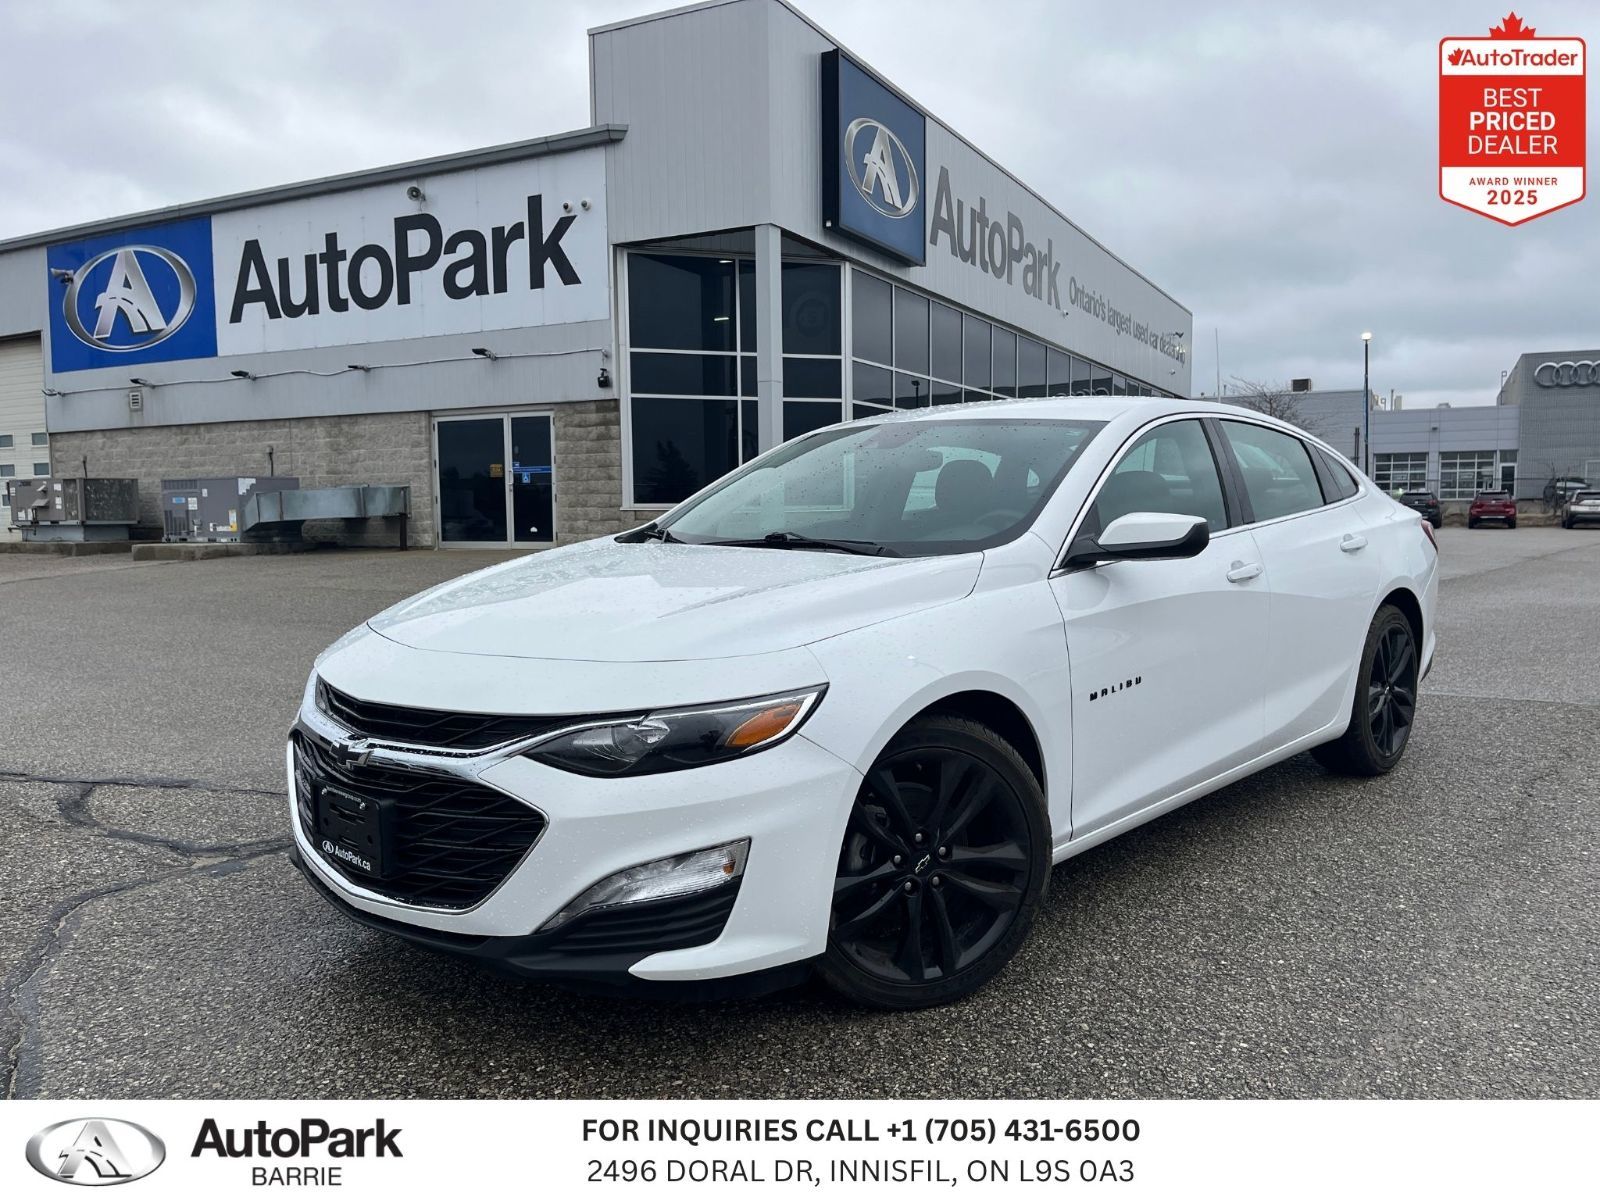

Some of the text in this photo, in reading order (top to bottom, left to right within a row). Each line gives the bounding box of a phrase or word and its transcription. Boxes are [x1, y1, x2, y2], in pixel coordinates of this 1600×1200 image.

[229, 194, 582, 324] AutoPark
[929, 165, 1062, 309] AutoPark
[1069, 276, 1106, 321] Ontario's
[1107, 299, 1132, 335] largest
[1133, 320, 1149, 344] used
[1149, 331, 1159, 350] car
[1089, 676, 1142, 702] MALIBU
[335, 845, 371, 871] AutoPark.ca
